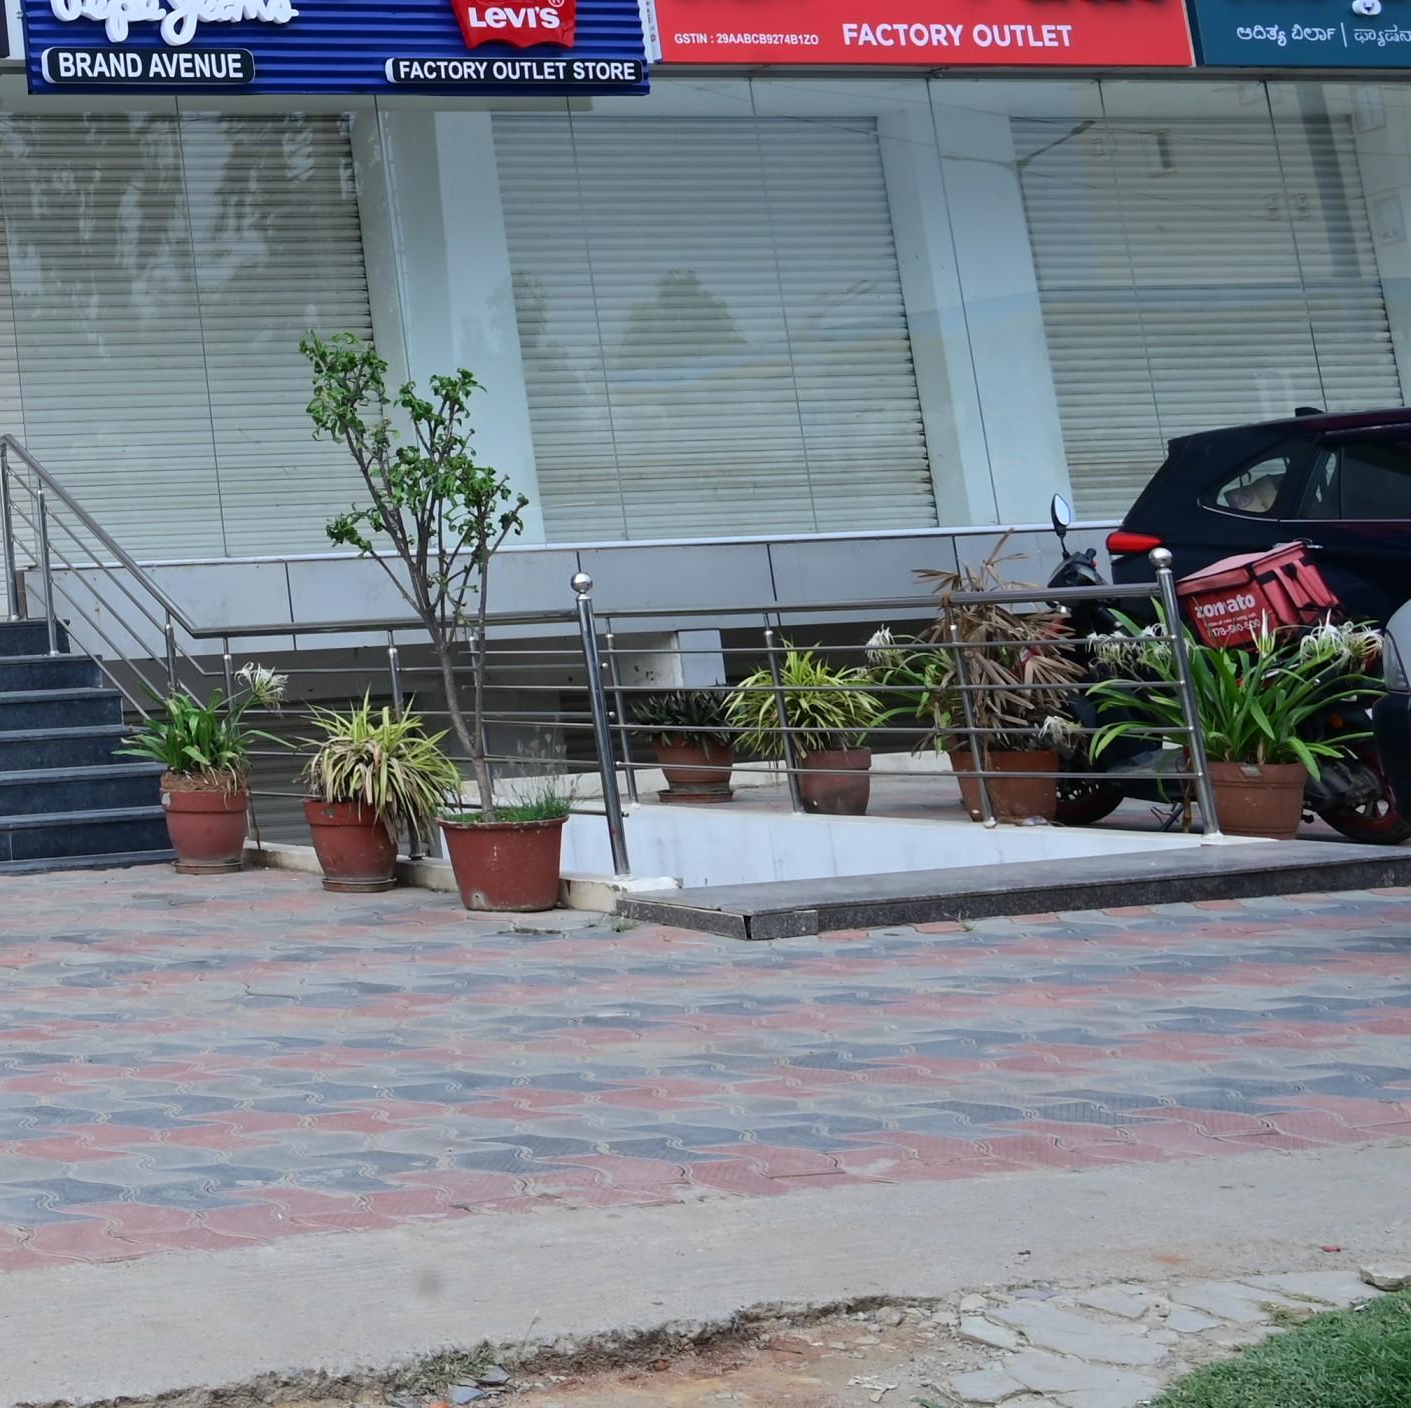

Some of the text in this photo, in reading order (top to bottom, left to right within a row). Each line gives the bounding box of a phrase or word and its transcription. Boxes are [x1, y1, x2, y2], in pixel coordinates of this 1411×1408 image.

[674, 33, 708, 45] GSTIN
[842, 23, 1073, 48] FACTORY OUTLET
[1236, 24, 1287, 46] ಆದಿತ್ಯ
[58, 53, 244, 80] BRAND AVENUE
[399, 61, 636, 81] FACTORY OUTLET STORE
[1194, 593, 1256, 619] zomato
